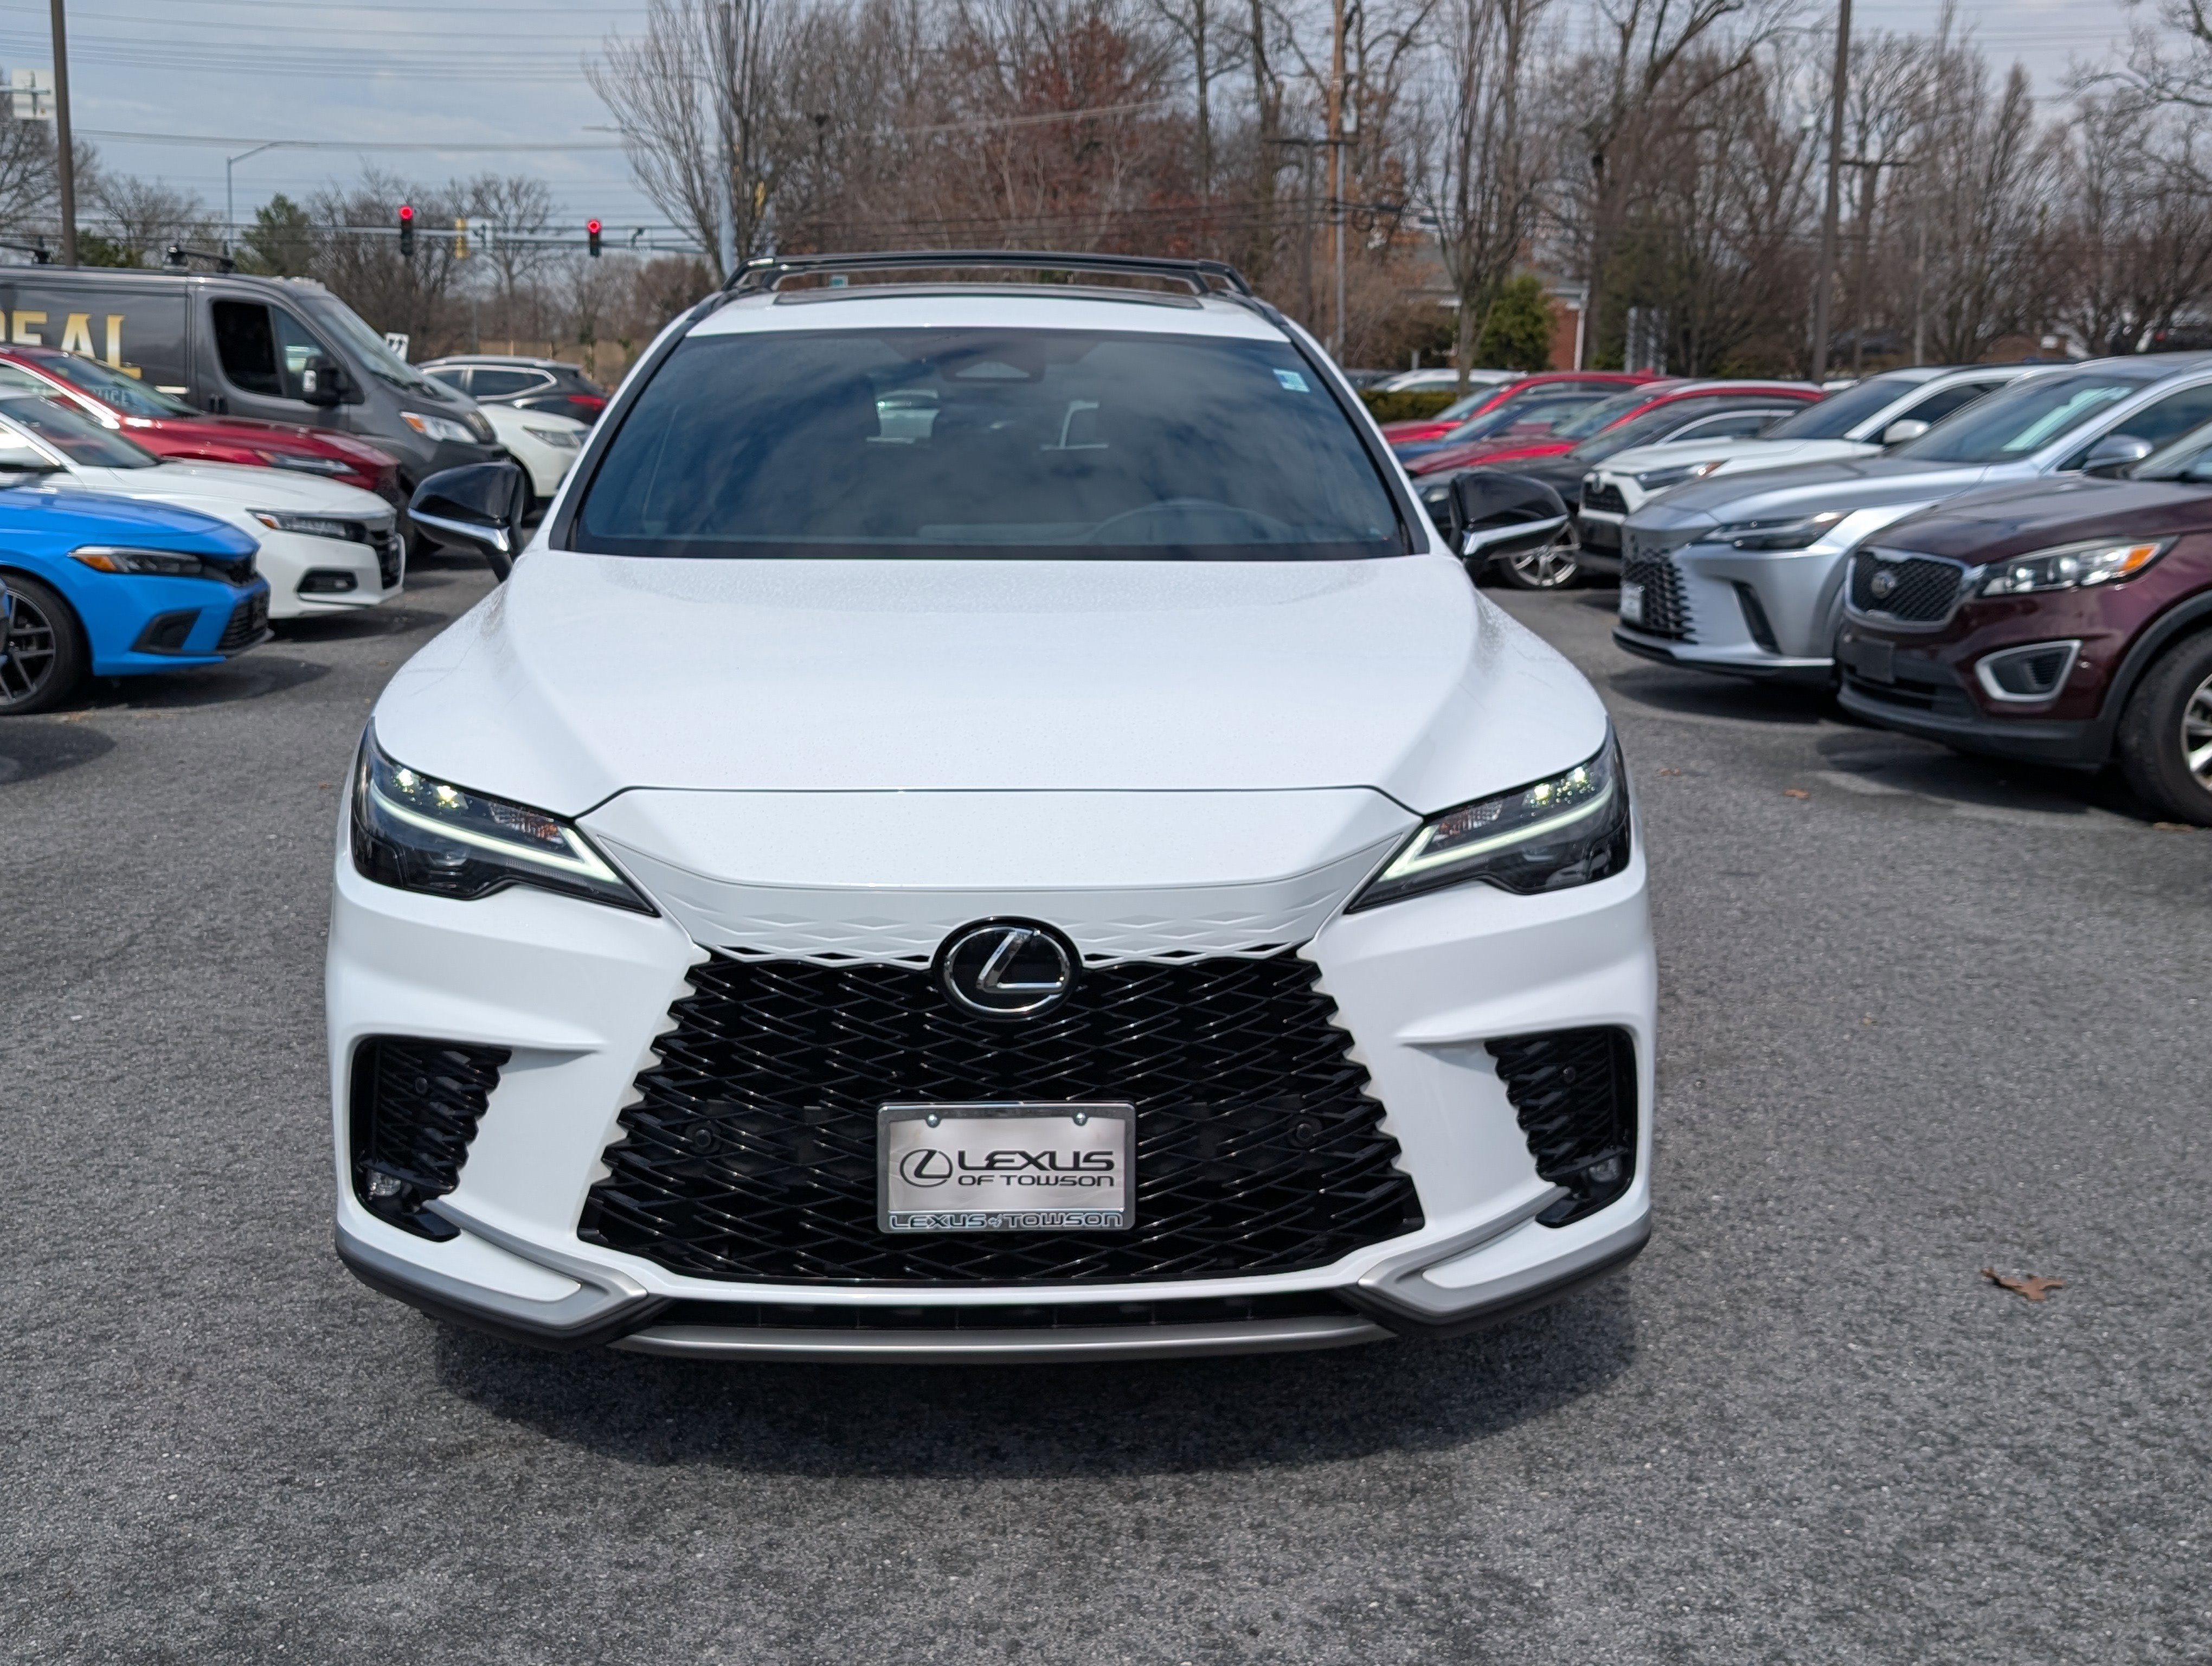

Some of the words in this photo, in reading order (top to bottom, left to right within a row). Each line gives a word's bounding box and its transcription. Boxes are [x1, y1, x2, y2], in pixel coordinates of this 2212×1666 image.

[958, 1150, 1114, 1171] LEXUS
[958, 1175, 994, 1186] OF
[999, 1175, 1114, 1187] TOWSON
[890, 1214, 987, 1229] LEXUS
[1004, 1213, 1123, 1227] TOWSON
